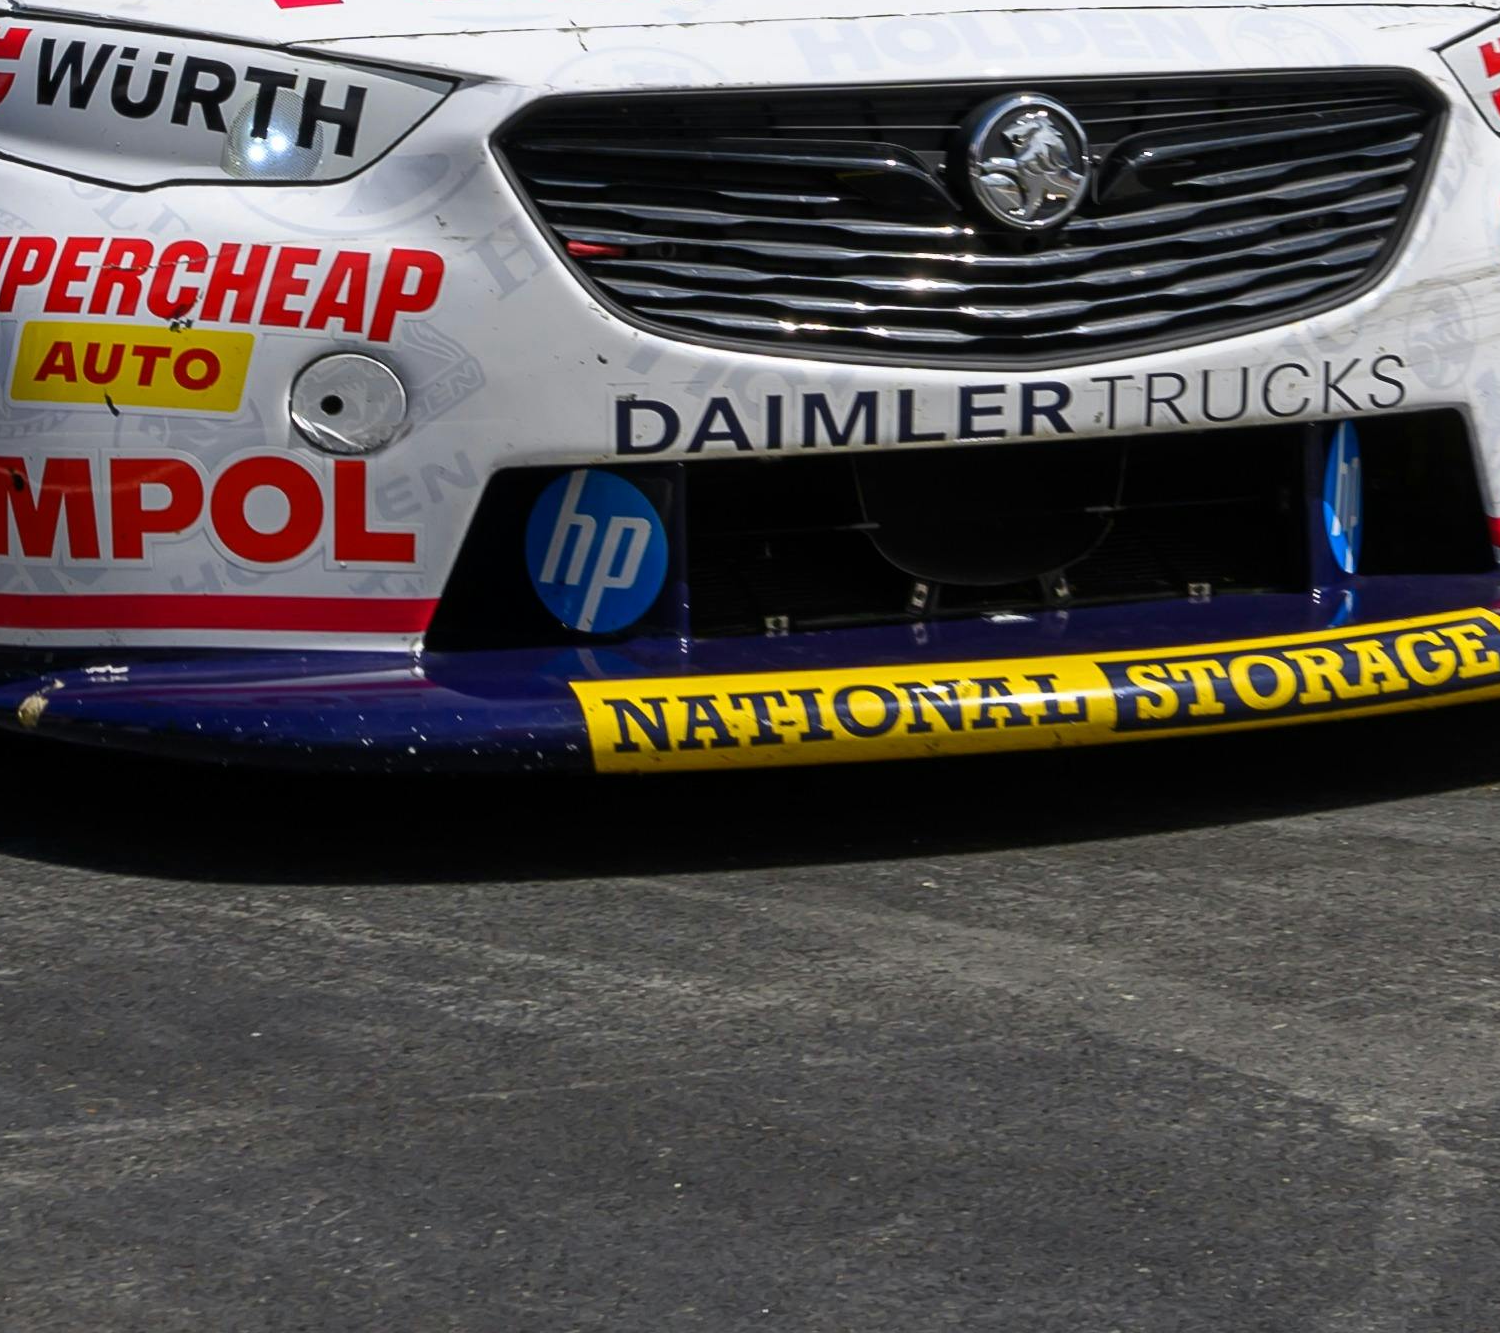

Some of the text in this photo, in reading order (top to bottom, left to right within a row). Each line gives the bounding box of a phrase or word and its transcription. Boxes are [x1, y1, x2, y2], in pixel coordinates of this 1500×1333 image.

[35, 36, 368, 157] WÜRTH
[790, 10, 1222, 76] HOLDEN
[33, 340, 222, 392] AUTO
[615, 353, 1407, 456] DAIMLER TRUCKS
[540, 469, 652, 632] hp
[603, 622, 1500, 753] NATIONAL STORAGE
